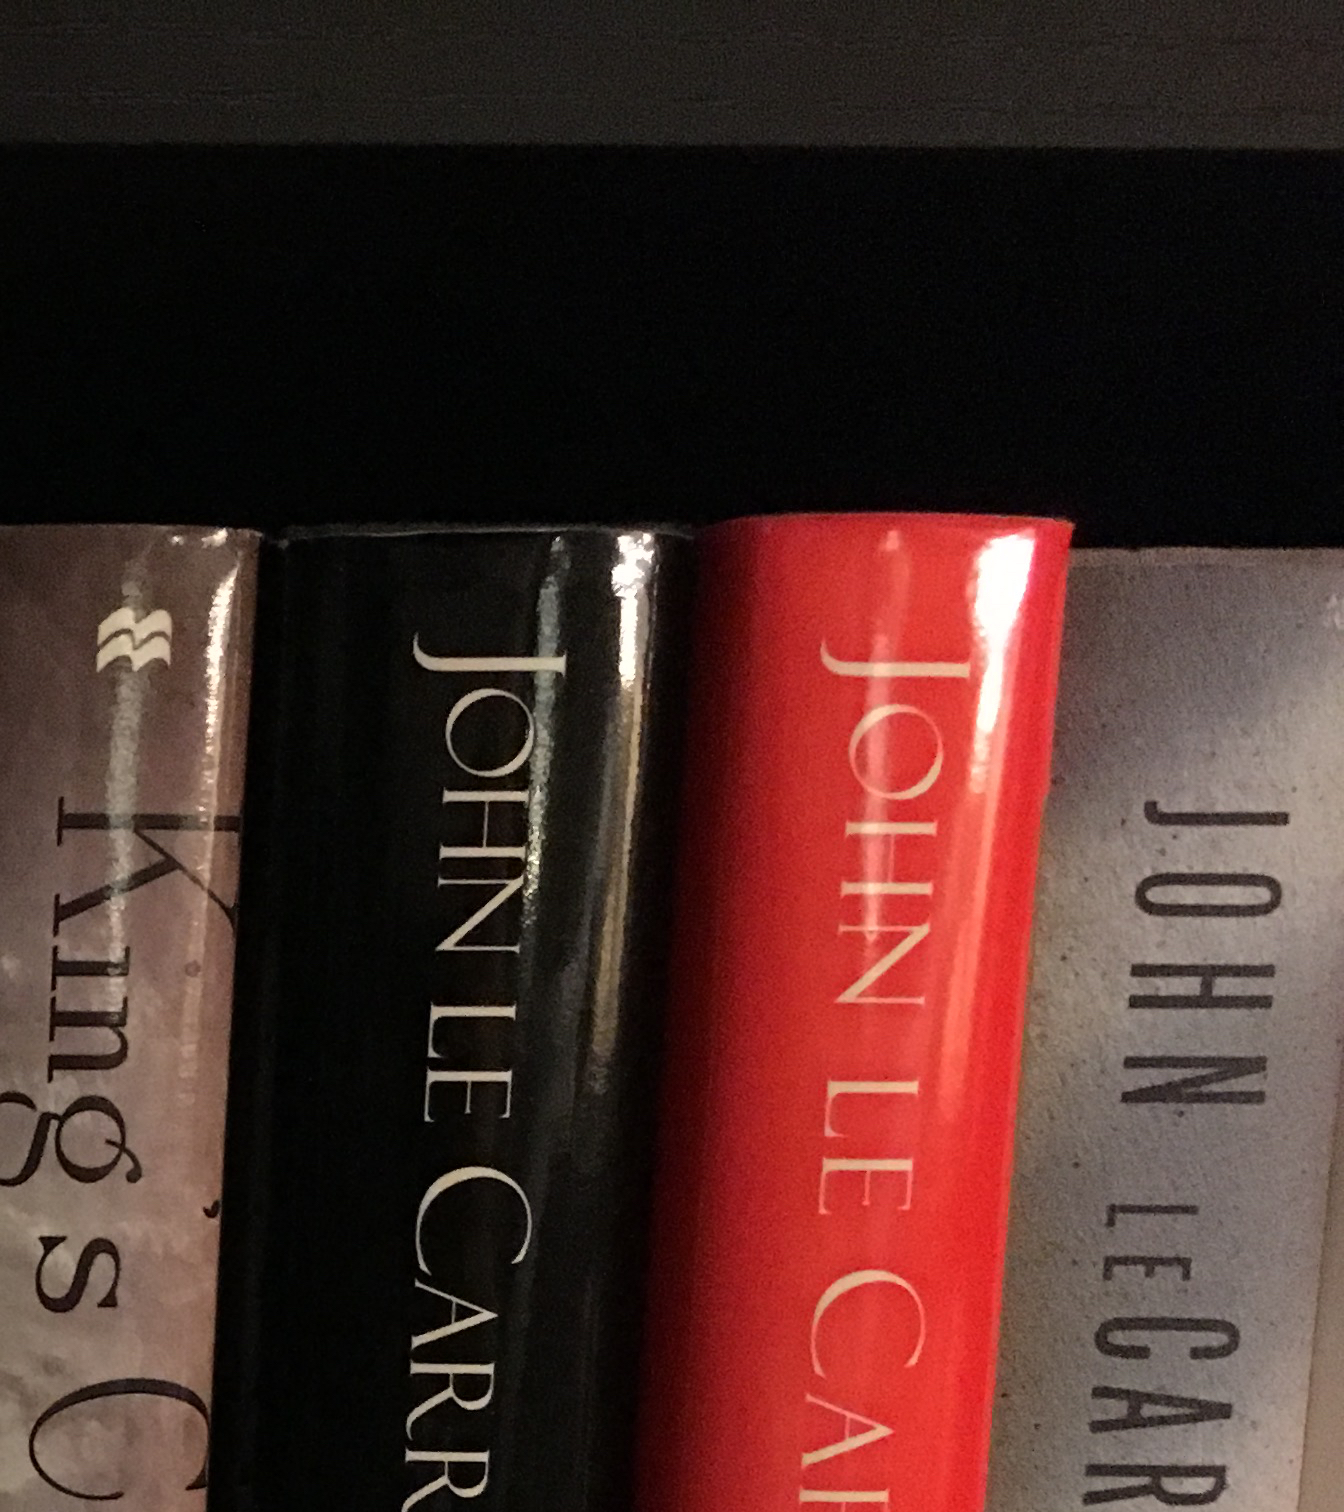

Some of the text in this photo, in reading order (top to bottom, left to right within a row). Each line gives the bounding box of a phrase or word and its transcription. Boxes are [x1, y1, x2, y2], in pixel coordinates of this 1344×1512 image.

[413, 632, 567, 955] JOHN
[820, 640, 971, 1007] JOHN
[422, 1002, 517, 1123] LE
[1120, 800, 1291, 1105] JOHN
[818, 1080, 920, 1215] LE
